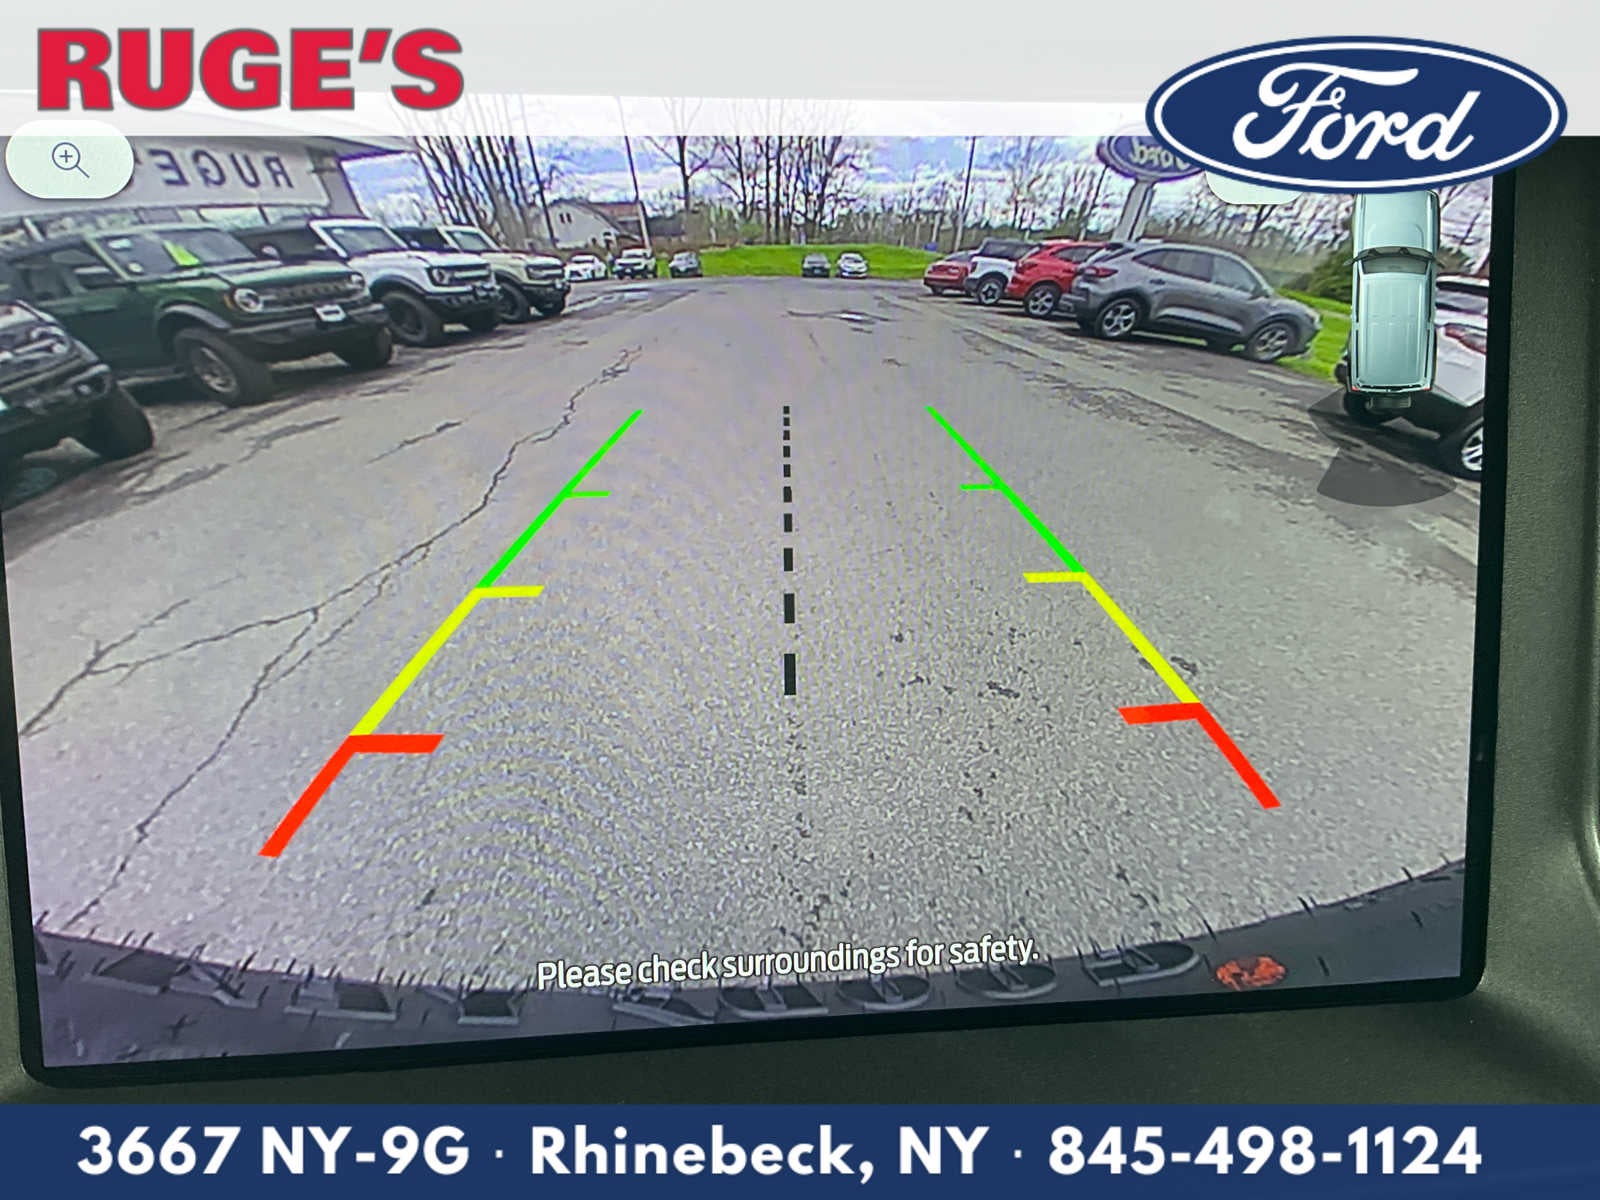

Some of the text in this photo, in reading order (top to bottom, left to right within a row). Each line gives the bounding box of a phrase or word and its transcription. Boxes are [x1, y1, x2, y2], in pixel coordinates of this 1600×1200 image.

[537, 934, 1040, 990] Please check surroundings for safety.
